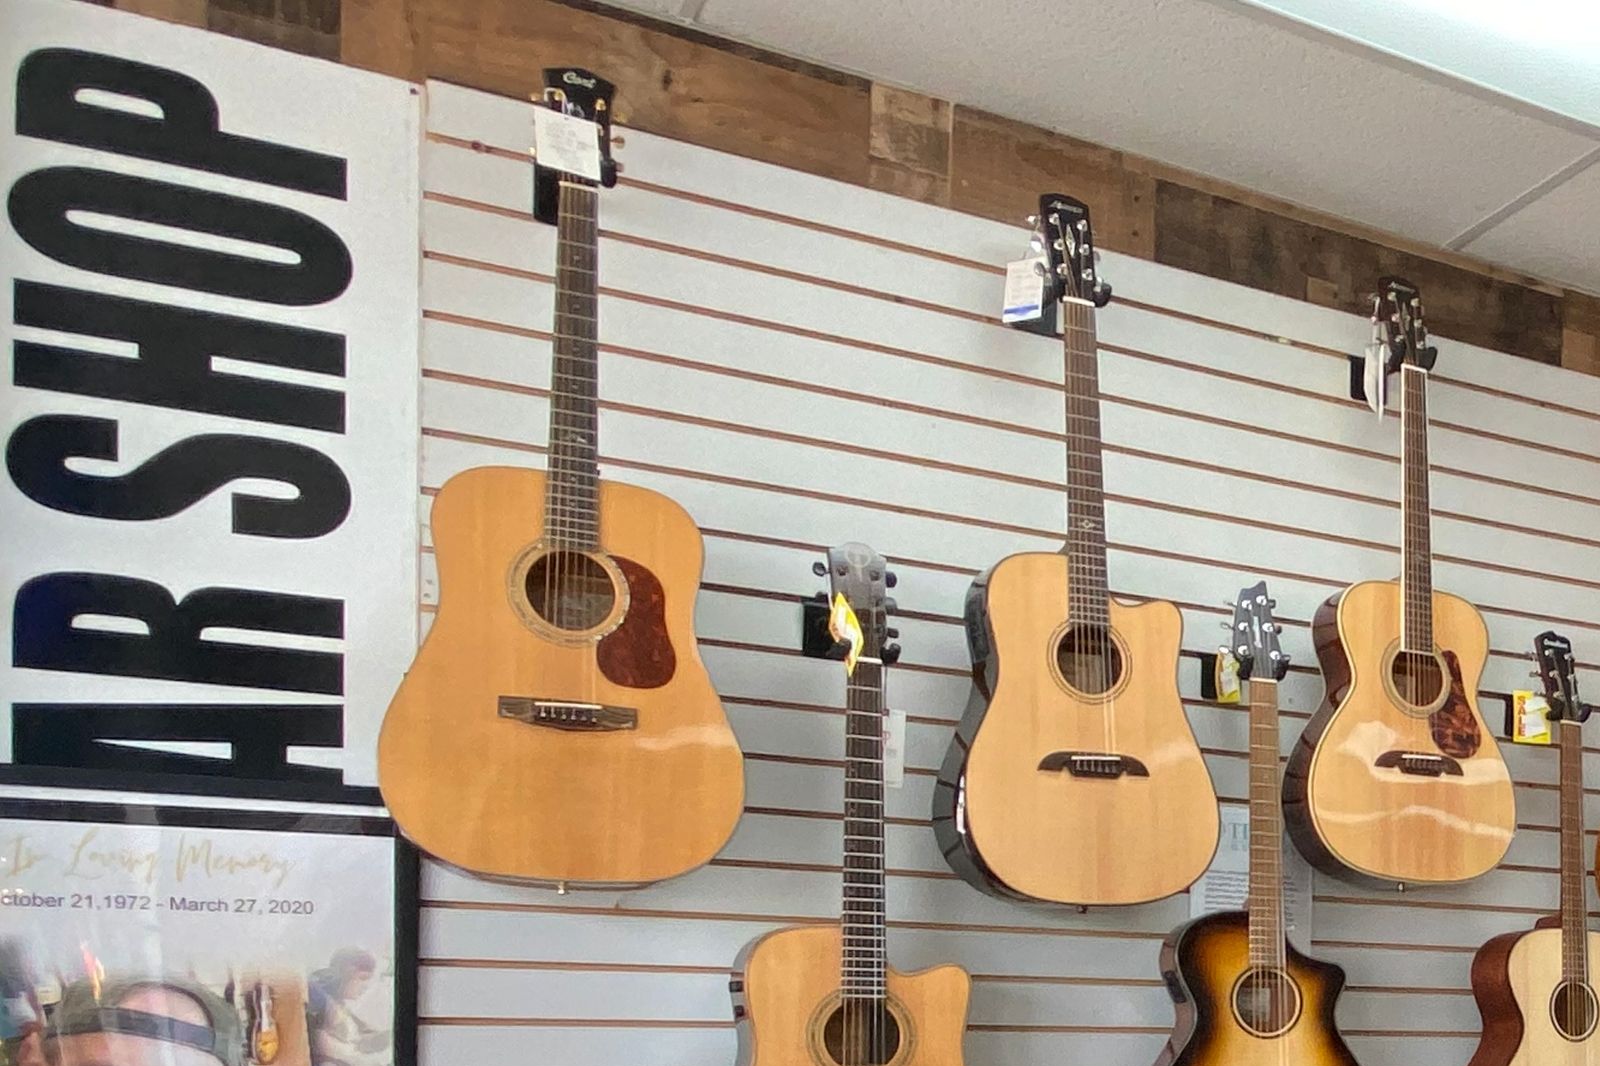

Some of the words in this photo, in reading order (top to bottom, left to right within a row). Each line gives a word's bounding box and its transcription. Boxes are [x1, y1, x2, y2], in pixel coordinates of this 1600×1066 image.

[6, 47, 353, 540] SHOP
[64, 827, 159, 883] Loving
[175, 833, 297, 888] Memory
[71, 893, 151, 910] 21,1972
[170, 896, 229, 913] March
[234, 898, 263, 915] 27,
[268, 899, 315, 916] 2020
